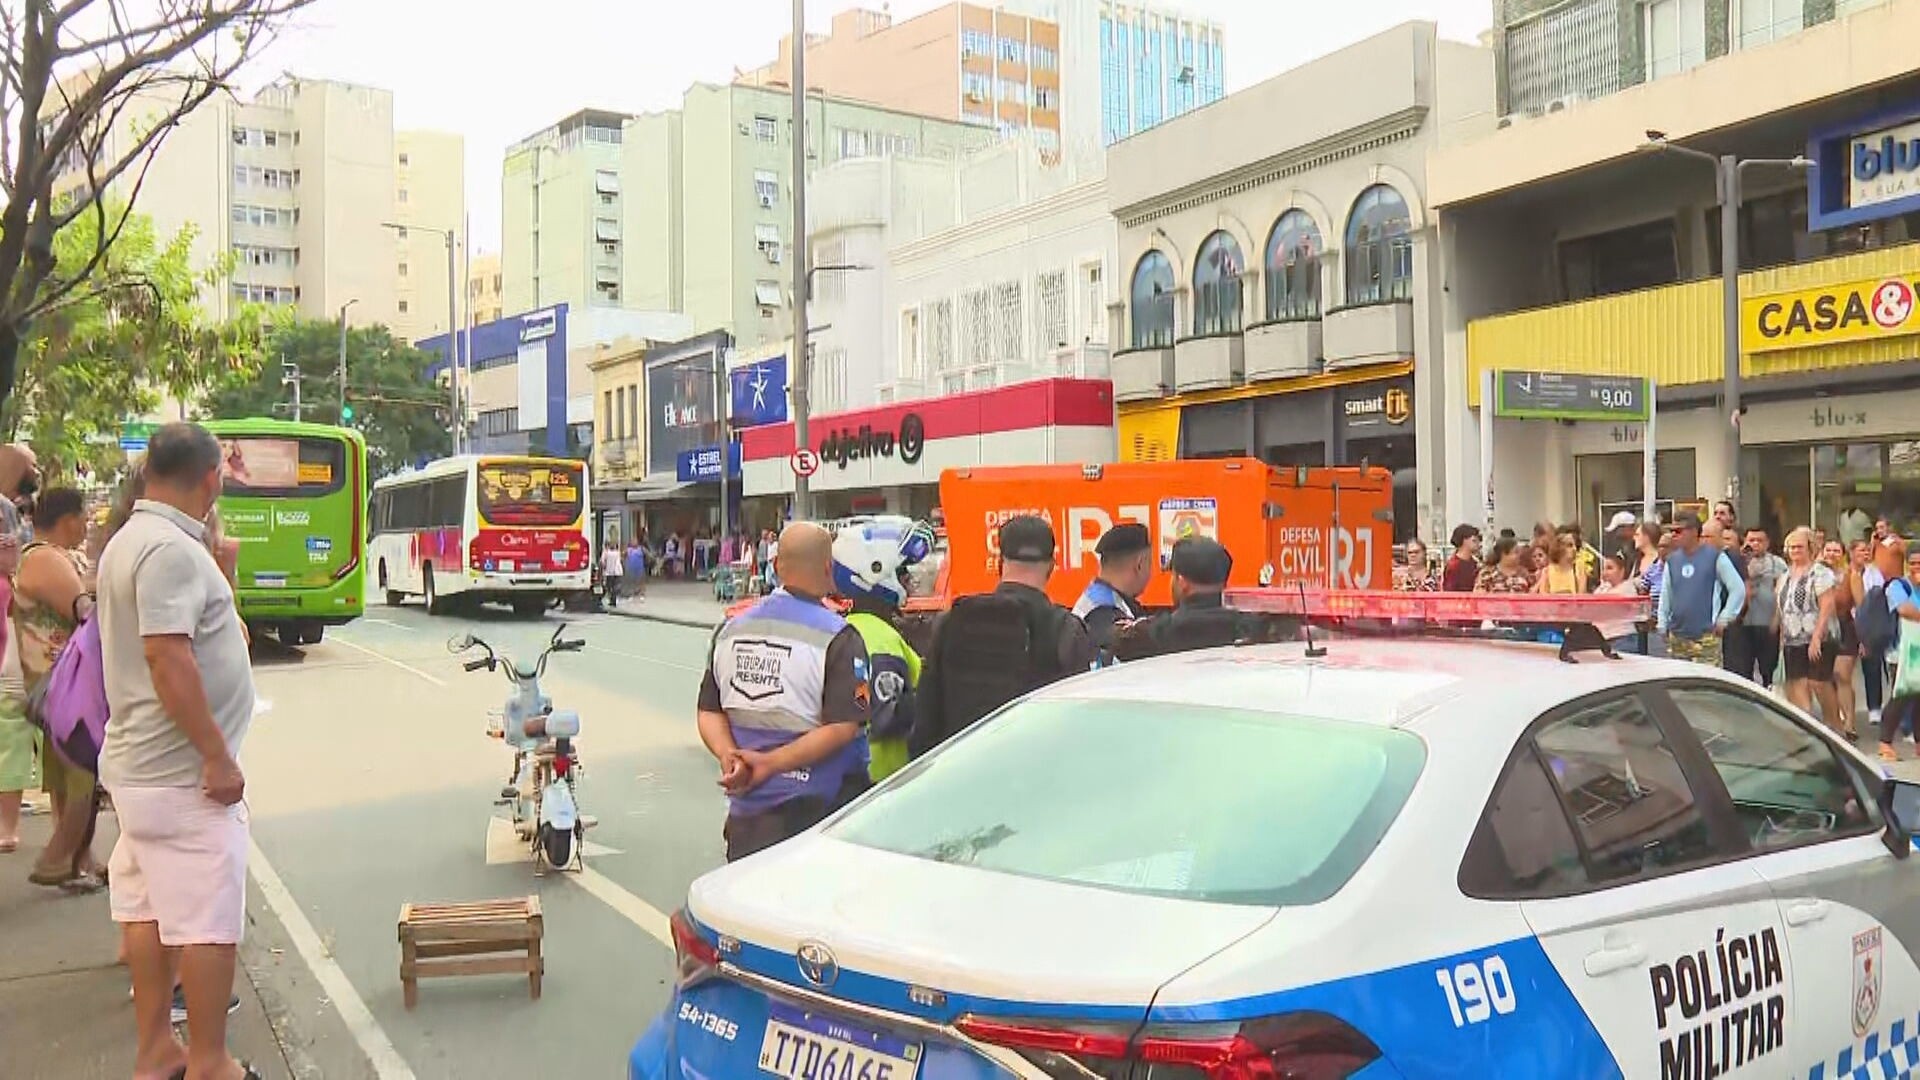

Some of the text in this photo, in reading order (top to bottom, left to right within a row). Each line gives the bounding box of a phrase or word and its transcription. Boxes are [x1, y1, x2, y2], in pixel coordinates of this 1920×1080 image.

[1758, 280, 1920, 338] CASA&
[1344, 389, 1409, 416] smart fit
[1601, 389, 1632, 409] 9,00
[1611, 427, 1643, 444] blu
[698, 450, 720, 467] ESTREL
[1280, 527, 1321, 544] DEFESA
[1280, 545, 1325, 575] CIVIL
[1329, 527, 1373, 590] RJ
[1436, 954, 1515, 1028] 190
[1650, 927, 1783, 1030] POLÍCIA
[678, 1002, 738, 1040] 54-1365
[1659, 995, 1784, 1080] MILITAR
